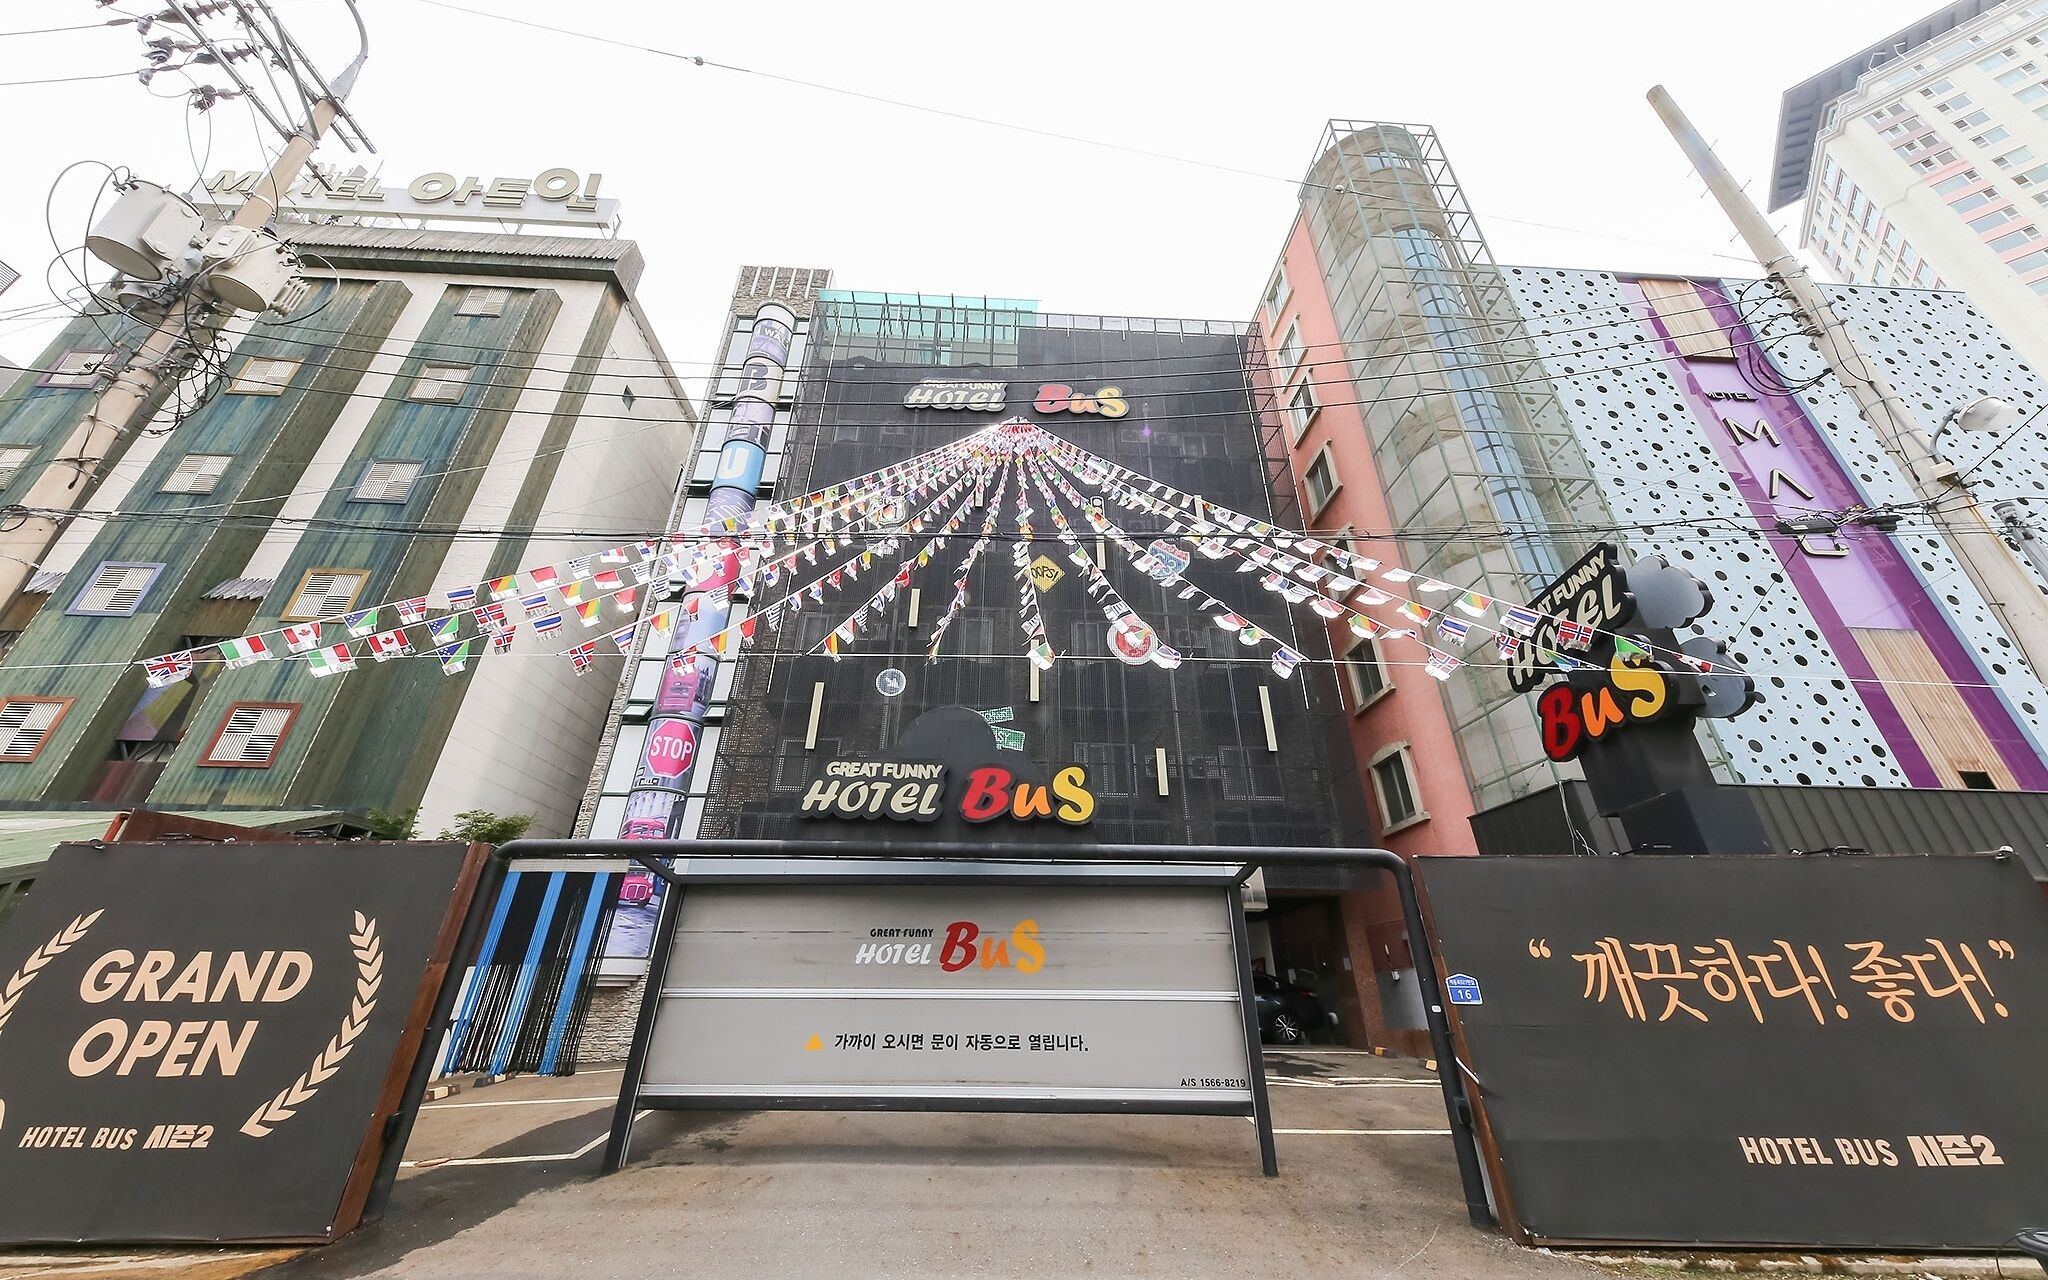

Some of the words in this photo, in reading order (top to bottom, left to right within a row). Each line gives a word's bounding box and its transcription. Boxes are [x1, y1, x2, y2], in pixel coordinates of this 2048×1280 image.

[206, 170, 385, 202] MTEL
[1552, 550, 1606, 606] FUNNY
[650, 735, 693, 761] STOP
[826, 761, 882, 778] GREAT
[882, 763, 943, 780] FUNNY
[869, 928, 901, 938] GREAT
[902, 928, 934, 938] FUNNY
[79, 949, 314, 1004] GRAND
[1457, 989, 1472, 1000] 16
[68, 1018, 260, 1078] OPEN
[834, 1033, 876, 1051] 가까이
[882, 1033, 924, 1051] 오시면
[930, 1034, 959, 1051] 문이
[965, 1034, 1022, 1051] 자동으로
[1028, 1034, 1089, 1052] 열립니다.
[1180, 1078, 1197, 1087] A/S
[1200, 1078, 1247, 1088] 1566-8219
[18, 1126, 87, 1148] HOTEL
[90, 1127, 138, 1150] BUS
[1738, 1135, 1833, 1166] HOTEL
[1834, 1137, 1899, 1167] BUS
